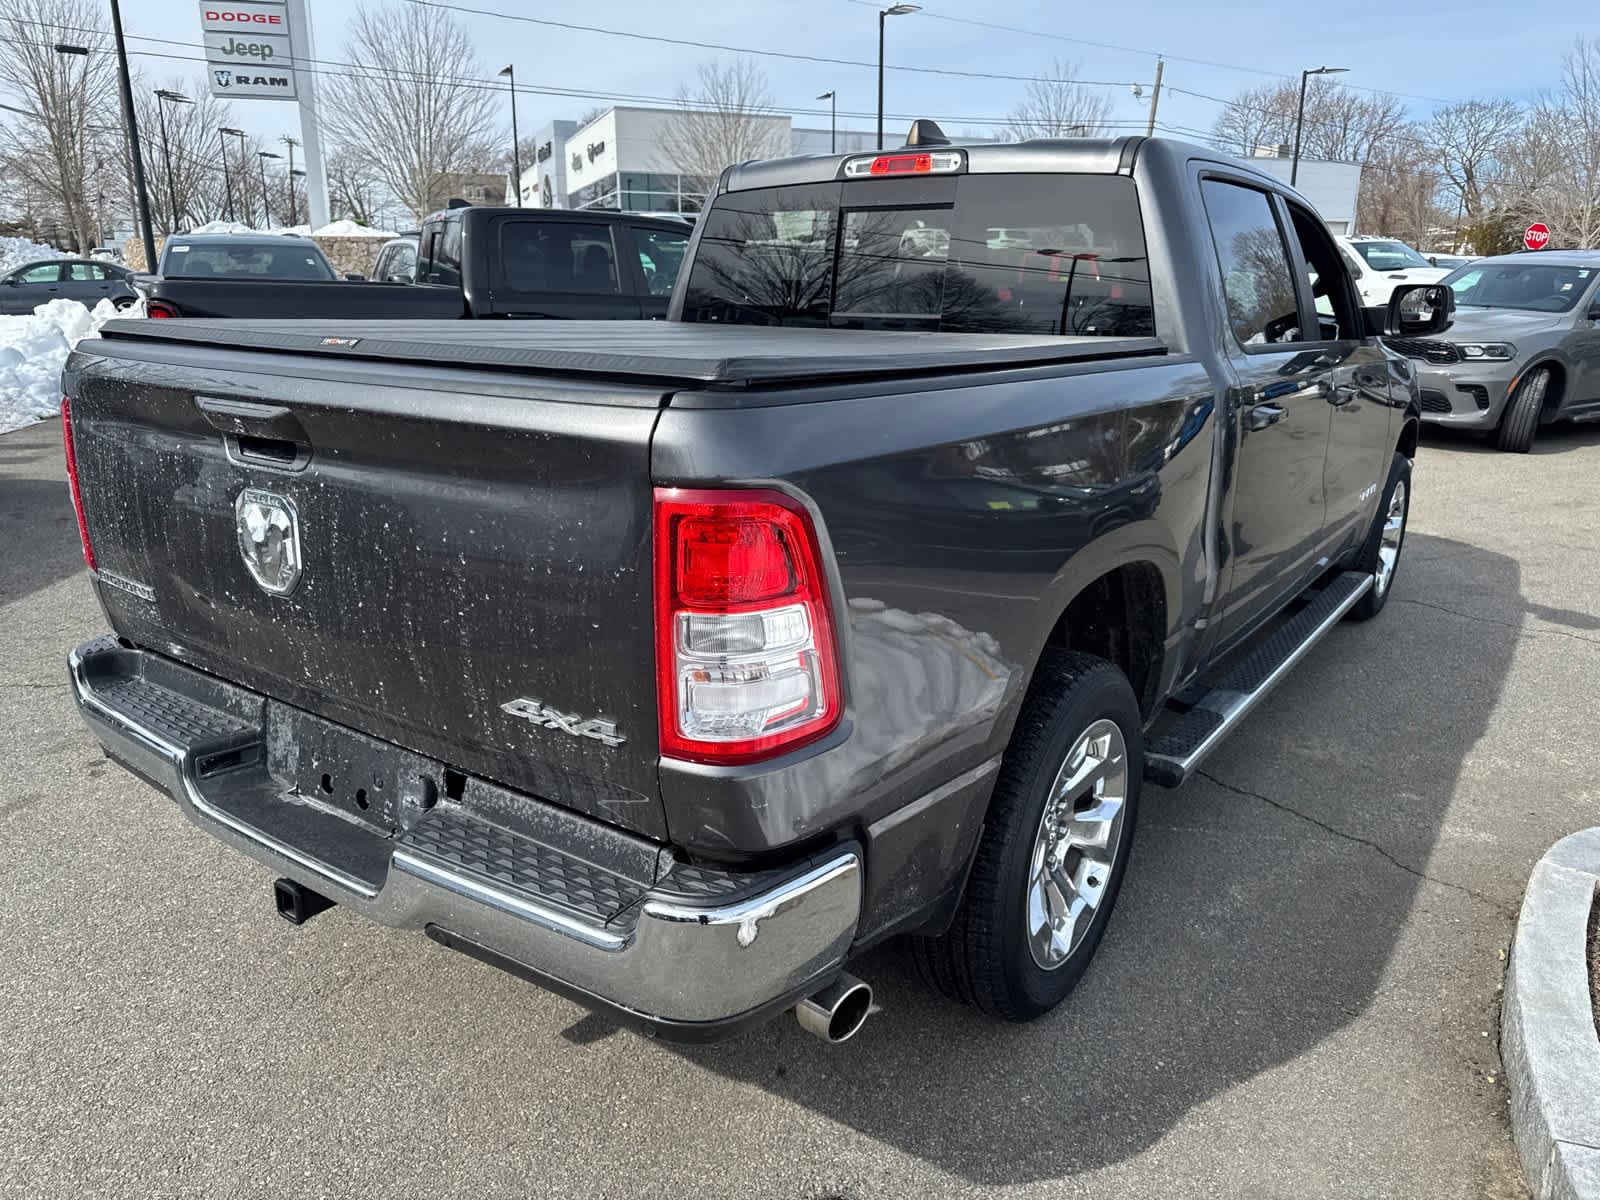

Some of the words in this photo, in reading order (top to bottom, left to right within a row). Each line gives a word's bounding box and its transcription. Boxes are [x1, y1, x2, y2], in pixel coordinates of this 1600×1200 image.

[205, 11, 282, 24] DODGE
[221, 37, 274, 61] Jeep
[235, 75, 288, 87] RAM
[1526, 230, 1548, 242] STOP
